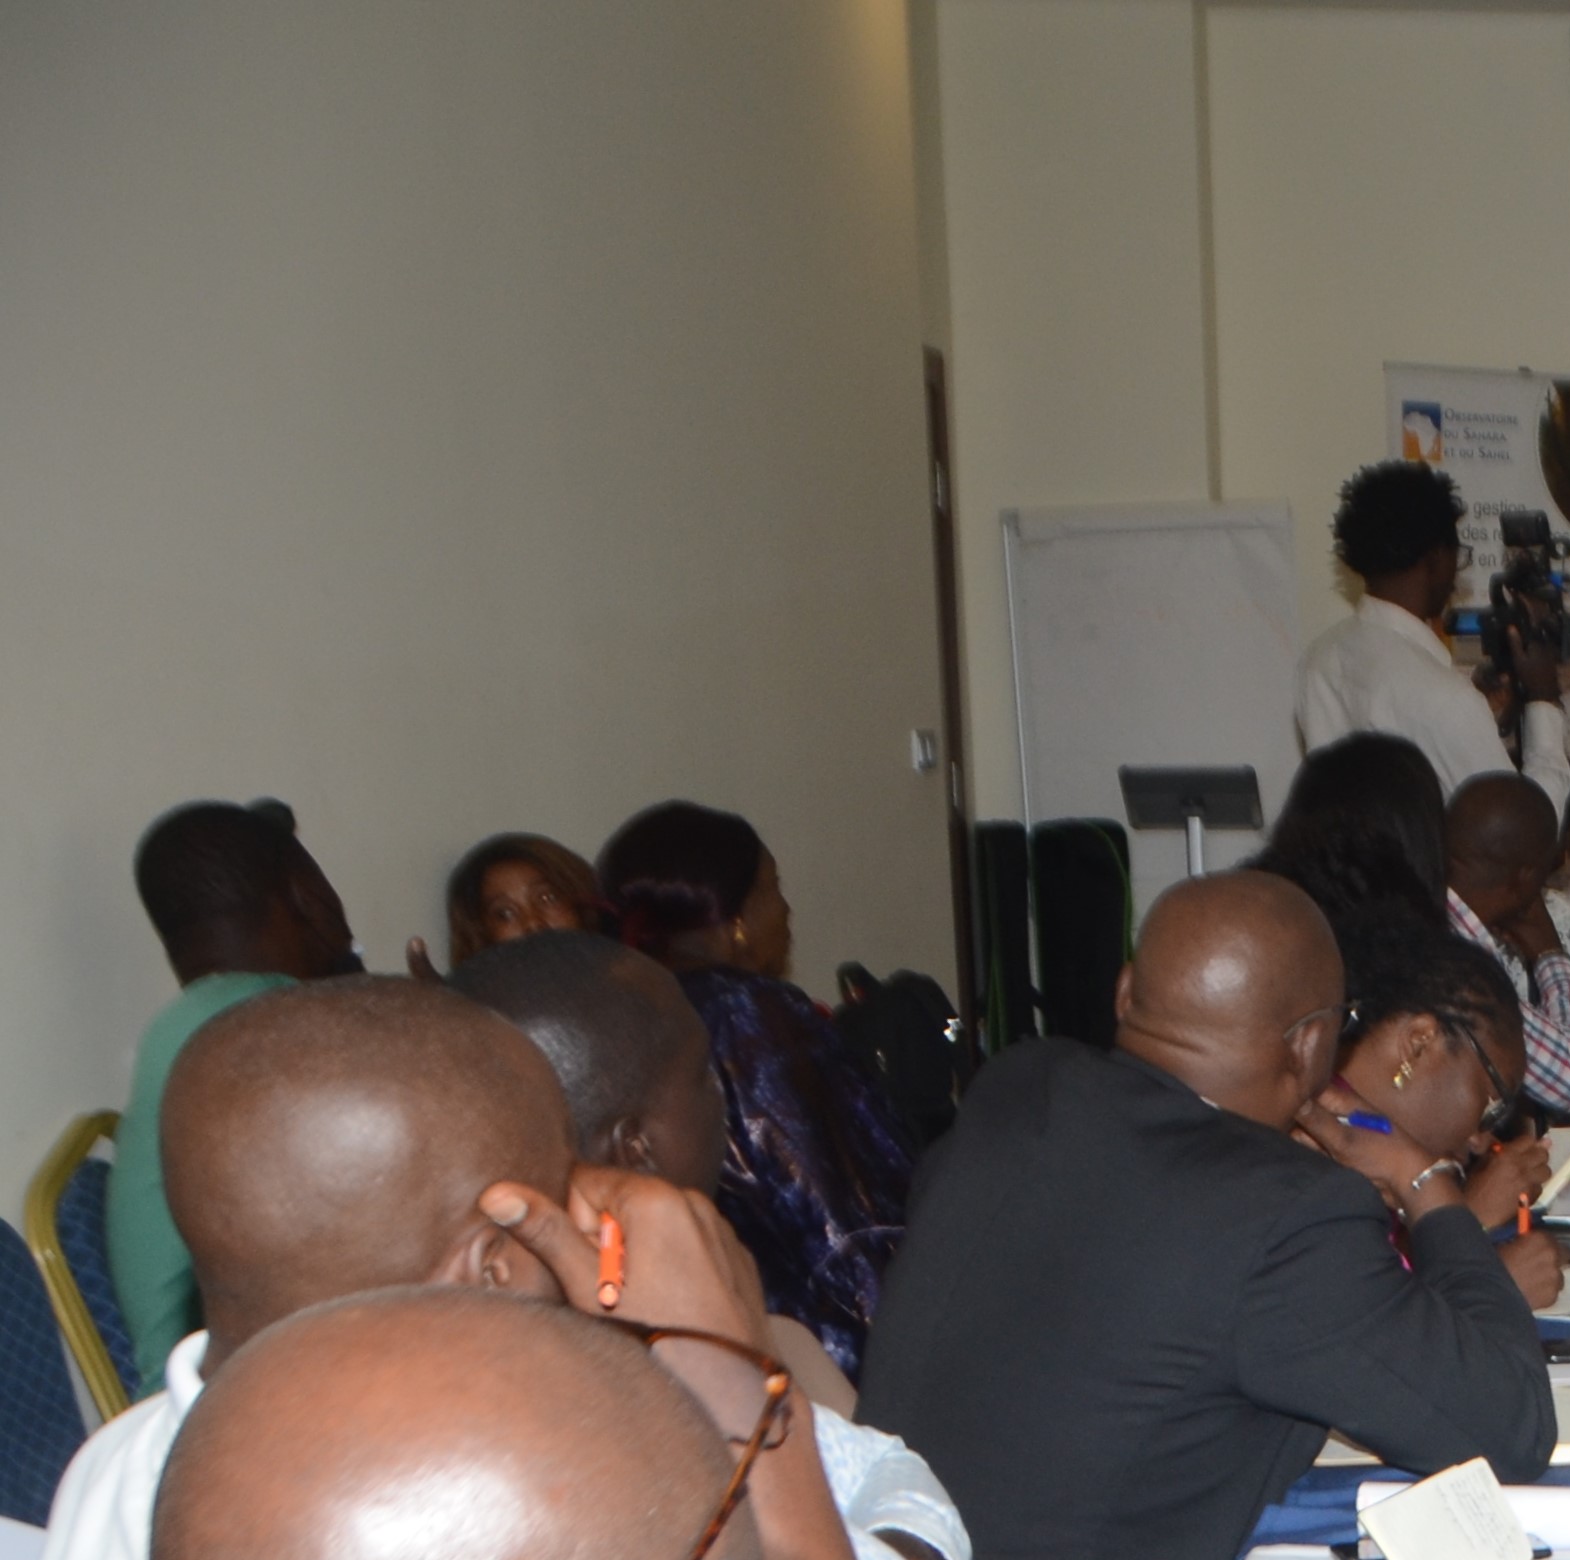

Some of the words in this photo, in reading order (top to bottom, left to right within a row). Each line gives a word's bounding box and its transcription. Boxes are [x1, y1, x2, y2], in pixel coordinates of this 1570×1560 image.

[1463, 428, 1507, 442] SAHARA
[1473, 499, 1526, 519] gestion
[1462, 523, 1489, 540] des
